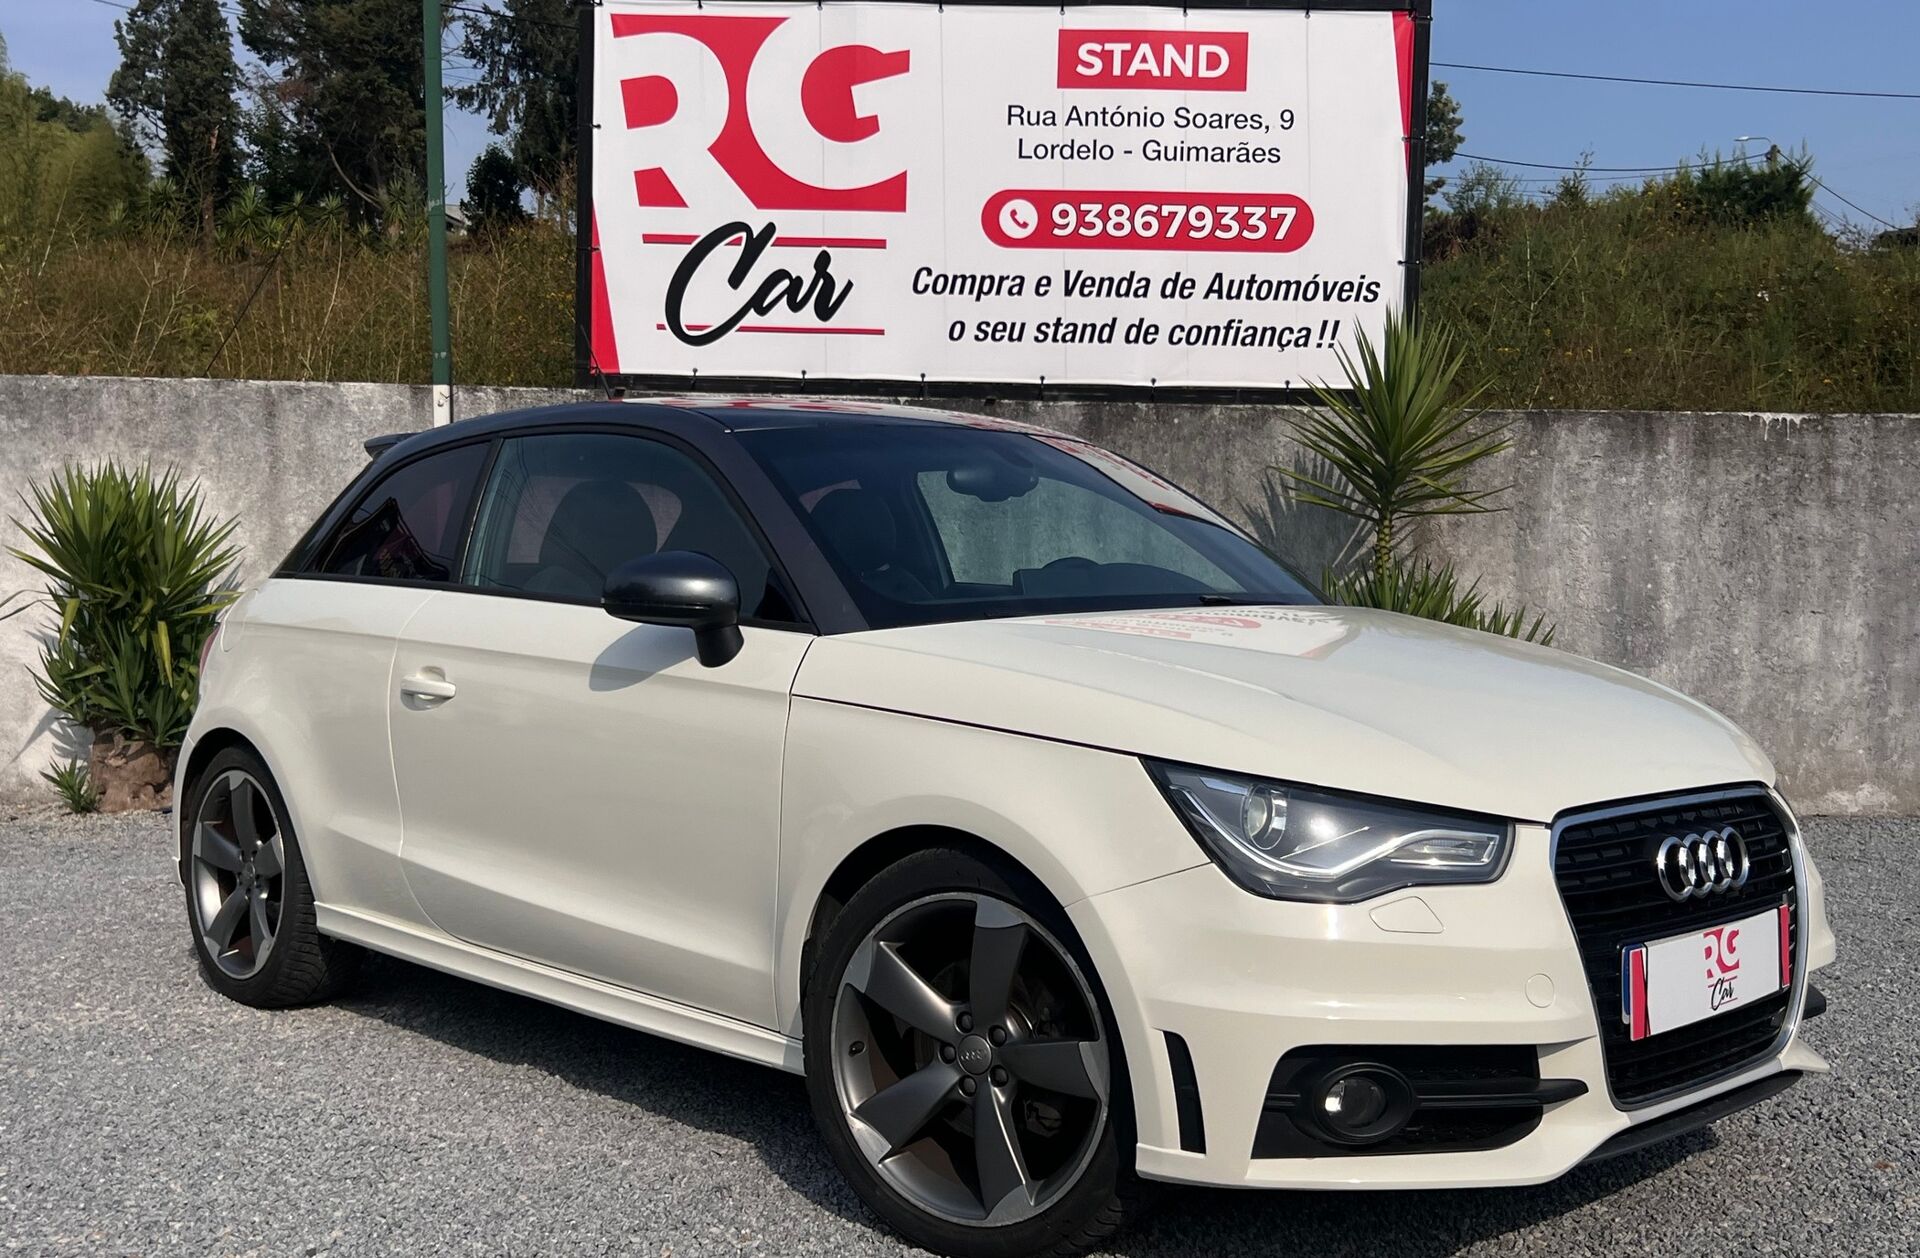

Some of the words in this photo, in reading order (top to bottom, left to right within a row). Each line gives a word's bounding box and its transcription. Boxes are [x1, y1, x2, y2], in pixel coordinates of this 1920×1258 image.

[1076, 42, 1230, 78] STAND
[611, 14, 911, 213] RG
[1007, 104, 1057, 127] Rua
[1064, 105, 1165, 129] António
[1173, 106, 1270, 134] Soares,
[1280, 109, 1295, 131] 9
[1018, 138, 1114, 161] Lordelo
[1142, 139, 1281, 164] Guimarães
[1051, 202, 1298, 240] 938679337
[664, 221, 854, 347] Car
[912, 266, 1026, 302] Compra
[1034, 275, 1052, 297] e
[1063, 269, 1151, 299] Venda
[1160, 271, 1196, 300] de
[1202, 272, 1381, 303] Automóveis
[948, 320, 966, 342] o
[973, 320, 1027, 343] seu
[1033, 316, 1118, 345] stand
[1124, 317, 1160, 345] de
[1703, 927, 1740, 979] RG
[1711, 977, 1734, 1011] Car
